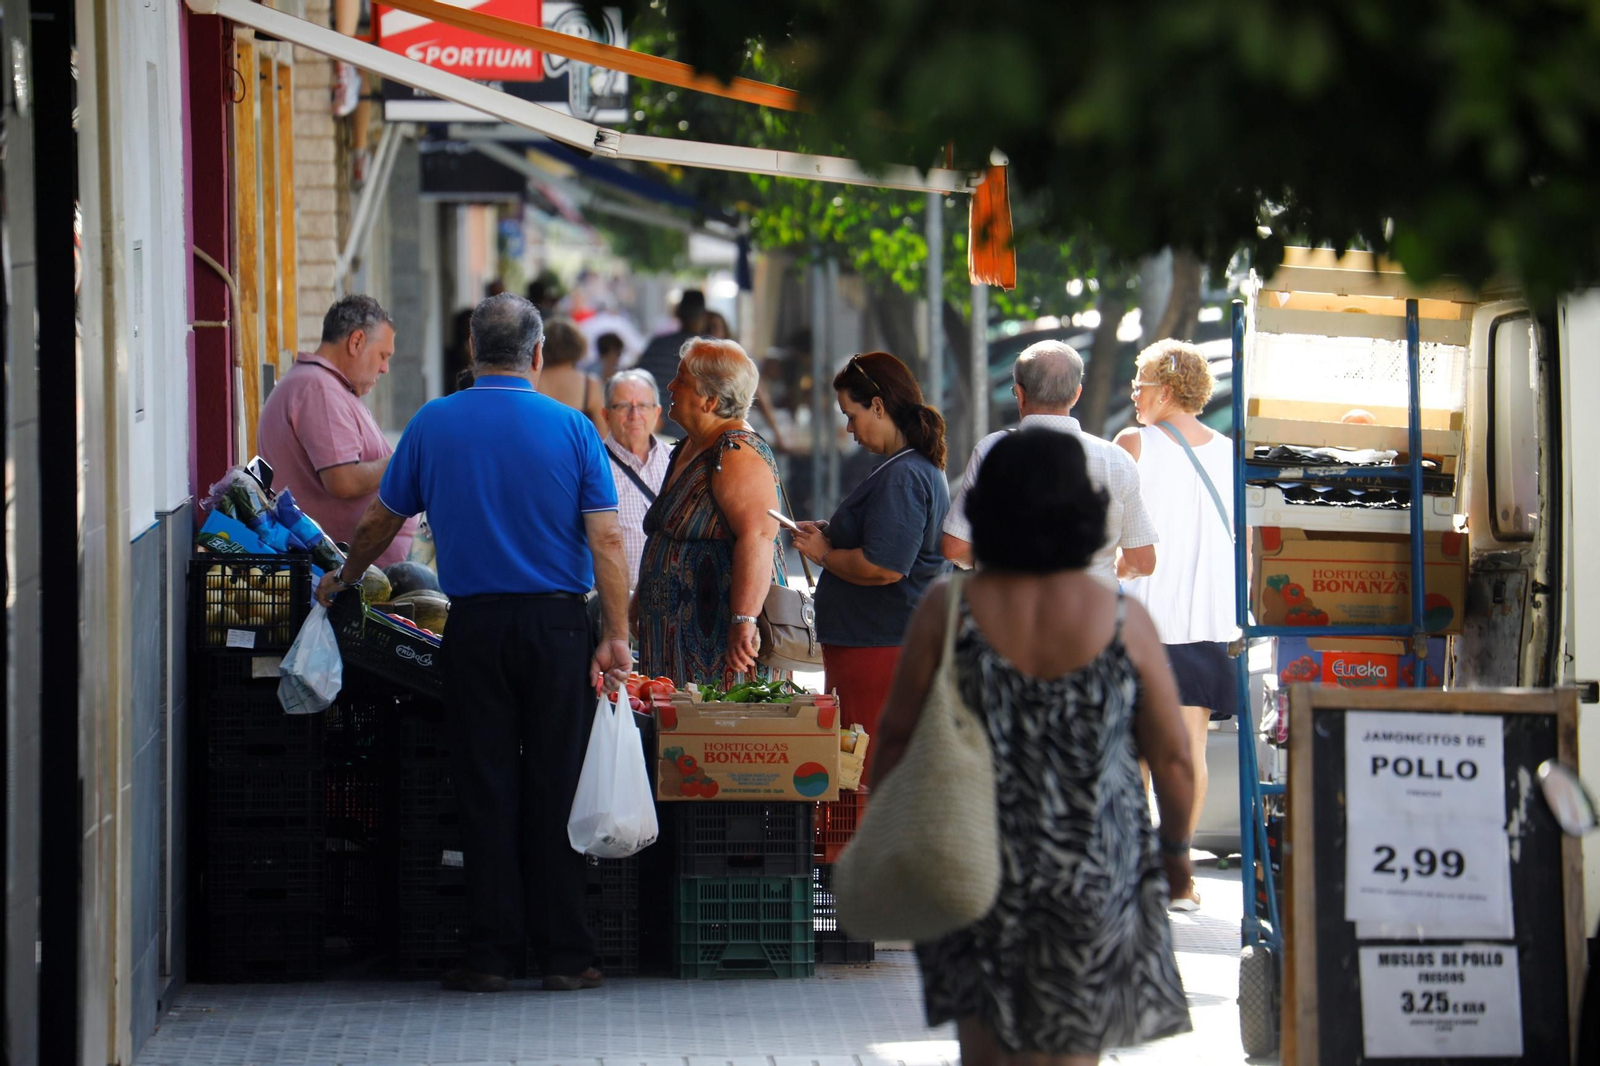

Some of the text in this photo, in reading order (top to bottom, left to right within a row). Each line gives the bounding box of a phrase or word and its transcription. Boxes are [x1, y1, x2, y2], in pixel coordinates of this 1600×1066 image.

[405, 39, 532, 68] SPORTIUM
[1312, 569, 1409, 581] HORTICOLAS
[1312, 580, 1409, 595] BONANZA
[1332, 659, 1387, 677] Eureka
[704, 742, 788, 751] HORTICOLAS
[1363, 731, 1486, 747] JAMONCITOS DE
[704, 752, 789, 764] BONANZA
[1371, 756, 1478, 780] POLLO
[1373, 845, 1465, 882] 2,99
[1378, 953, 1503, 967] MUSLOS DE POLLO
[1418, 972, 1465, 984] FRESCOS
[1402, 991, 1449, 1014] 3.25
